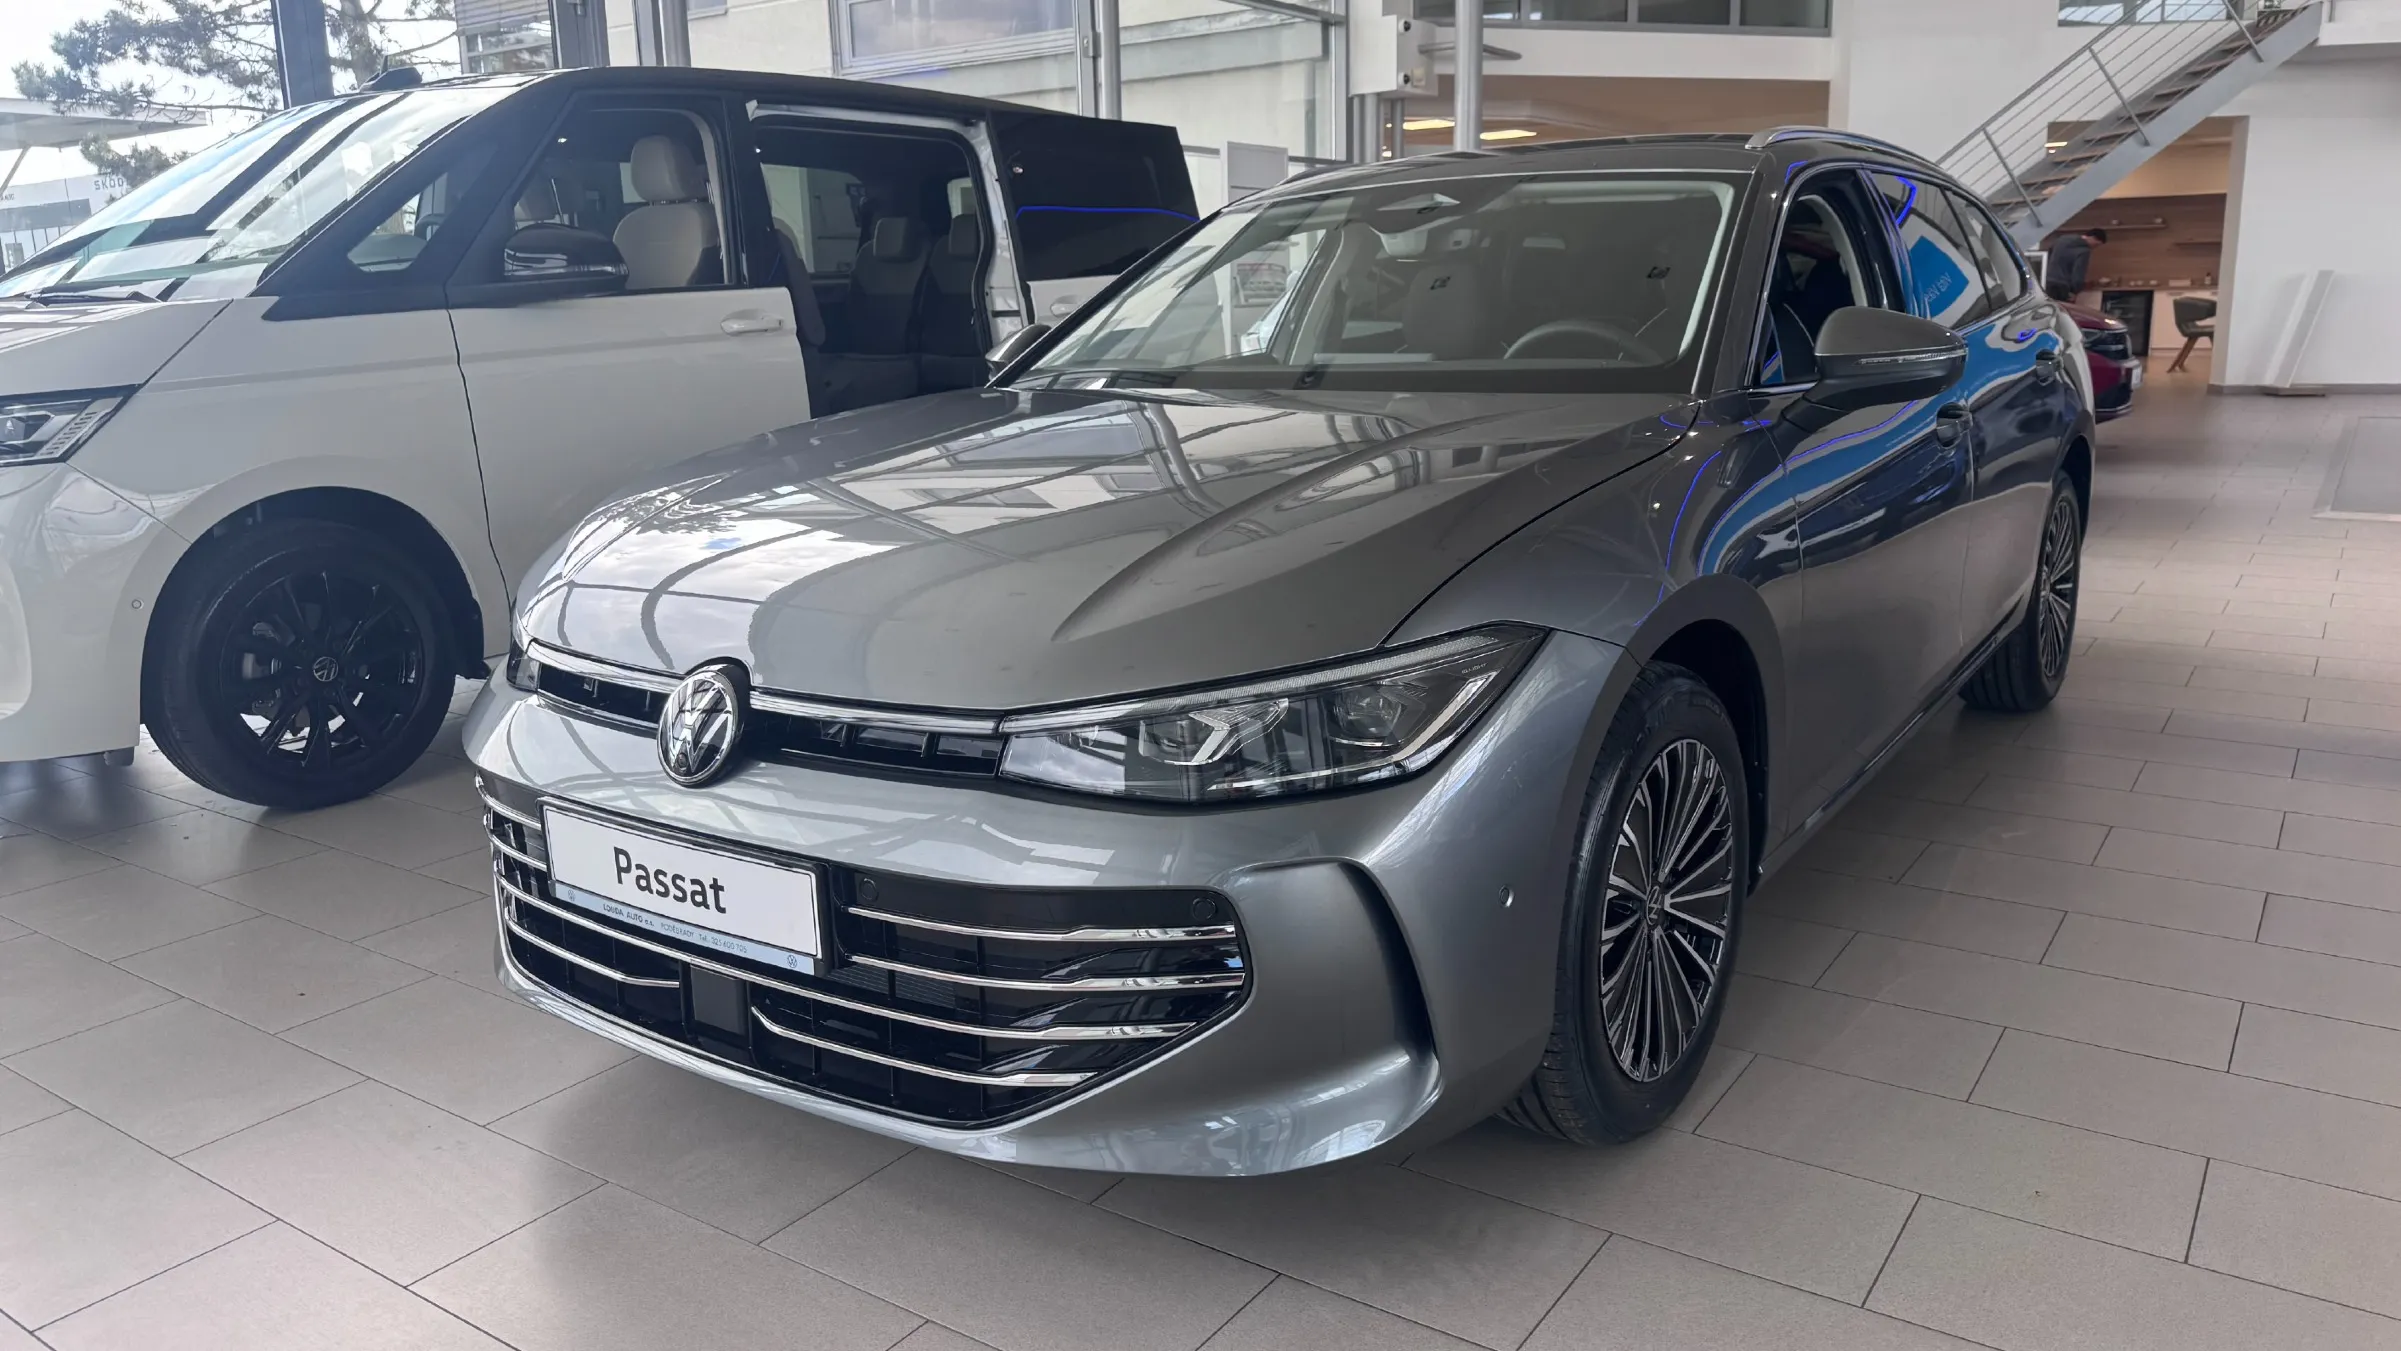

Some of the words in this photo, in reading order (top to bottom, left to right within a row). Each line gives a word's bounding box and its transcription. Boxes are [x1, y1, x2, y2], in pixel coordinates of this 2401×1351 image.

[613, 846, 727, 914] Passat
[603, 903, 625, 917] LOUDA
[626, 911, 643, 923] AUTO
